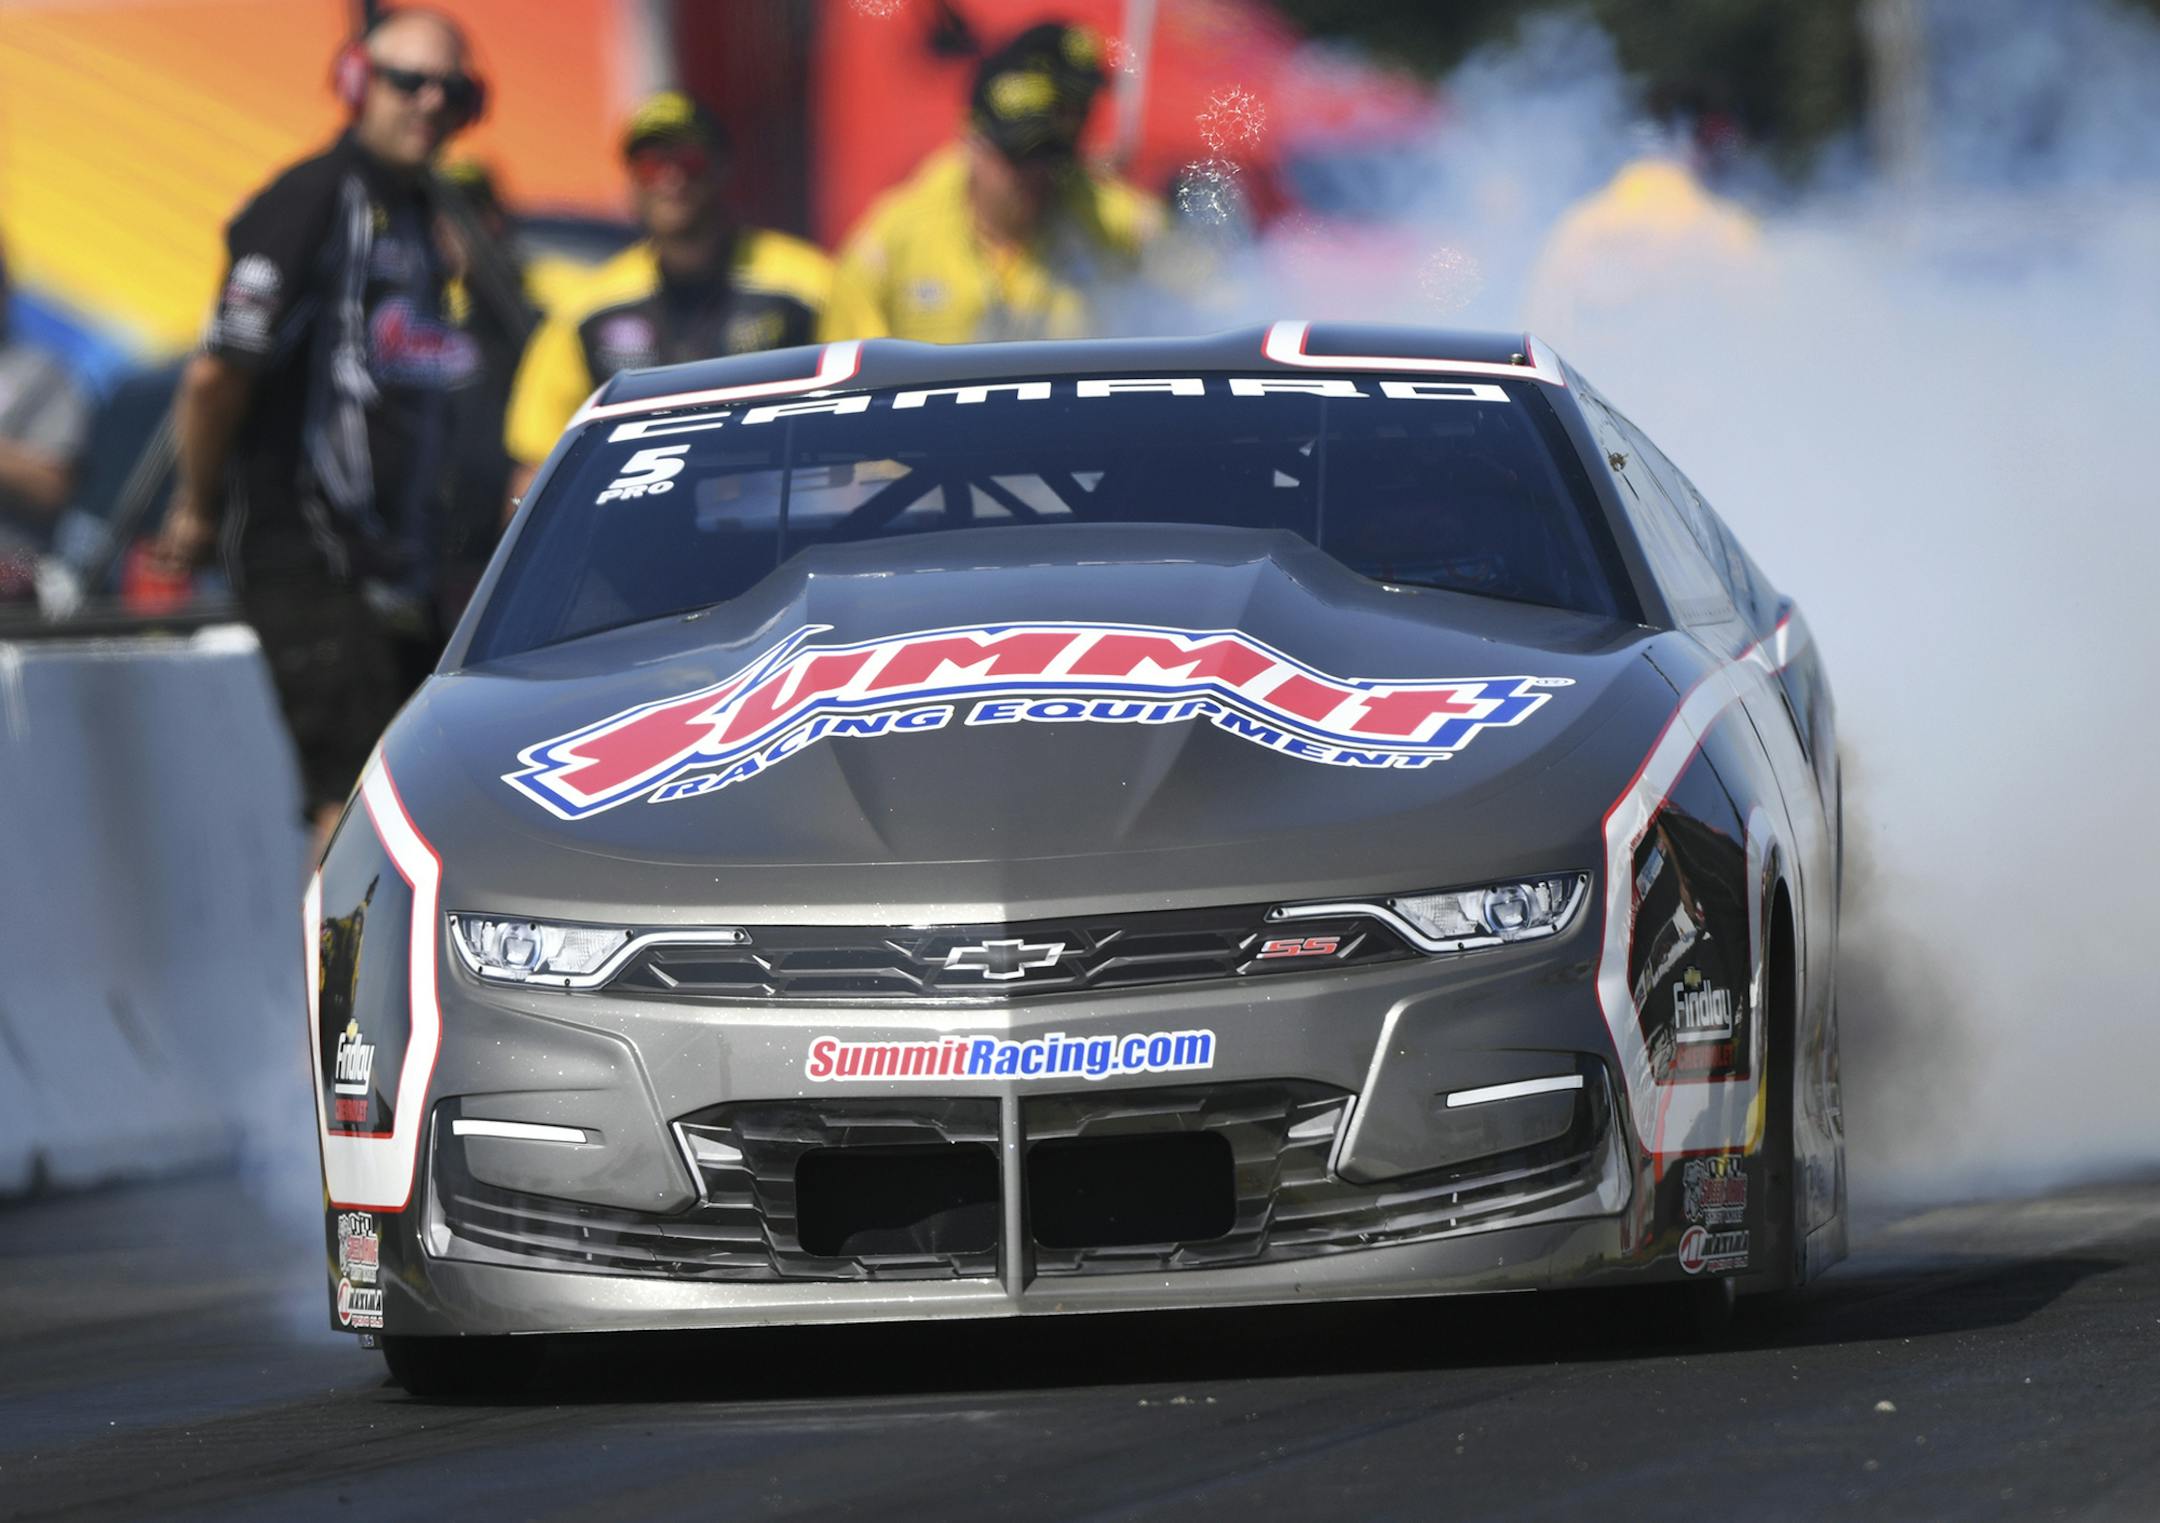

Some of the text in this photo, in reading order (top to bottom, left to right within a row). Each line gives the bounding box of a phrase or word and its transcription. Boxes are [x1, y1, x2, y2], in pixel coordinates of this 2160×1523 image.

[608, 378, 1511, 443] CAMARO
[596, 480, 674, 505] PRO
[608, 444, 691, 489] 5
[655, 699, 1449, 801] RACING EQUIPMENT
[1258, 936, 1340, 960] SS
[1673, 979, 1732, 1043] Findlay
[335, 1032, 375, 1095] Findlay
[808, 1030, 1212, 1079] SummitRacing.com
